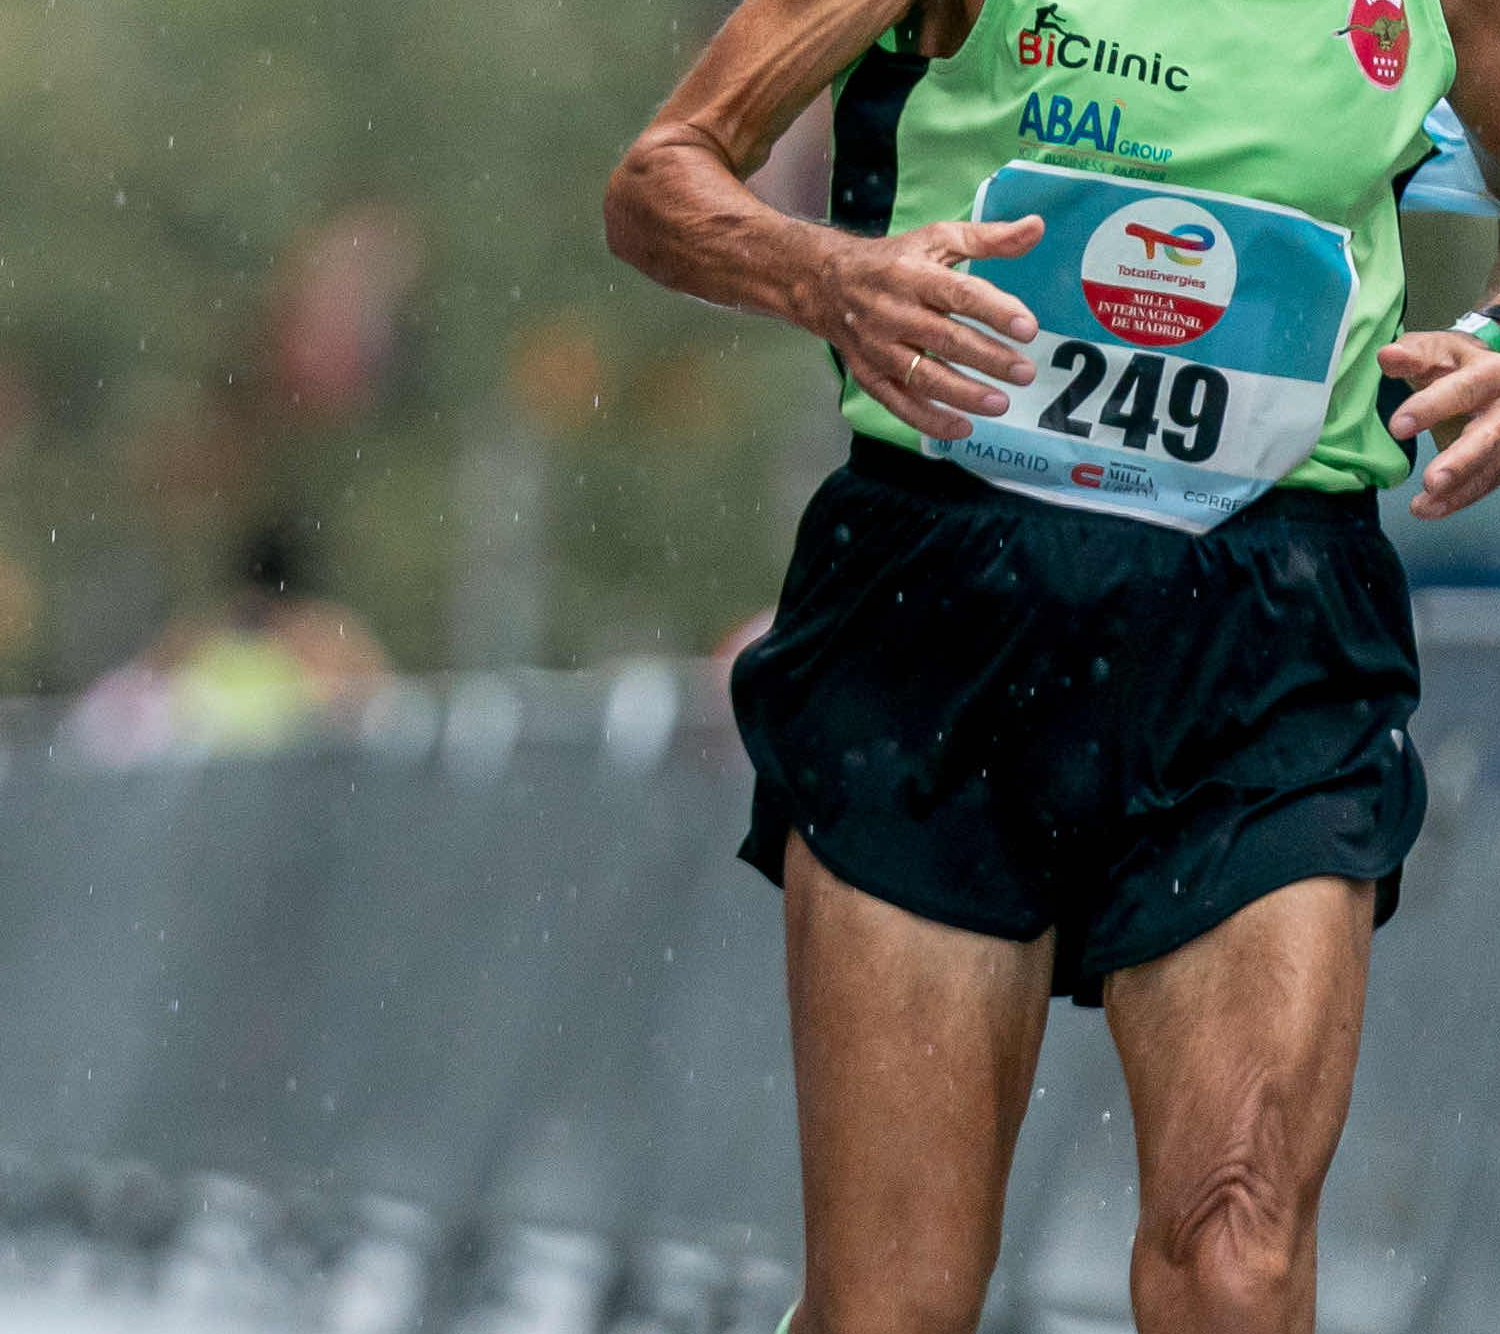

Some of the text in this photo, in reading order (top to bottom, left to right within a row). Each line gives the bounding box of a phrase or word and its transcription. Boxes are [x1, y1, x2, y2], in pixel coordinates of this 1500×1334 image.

[1018, 30, 1190, 92] BiClinic
[1018, 91, 1173, 164] ABAI GROUP
[1117, 264, 1206, 289] TotalEnergies
[1097, 300, 1204, 330] INTERNACIONAL
[1132, 293, 1175, 309] MILLA
[1111, 316, 1187, 339] DE MADRID
[1037, 339, 1229, 463] 249
[966, 439, 1049, 472] MADRID
[1107, 468, 1153, 488] MILLA
